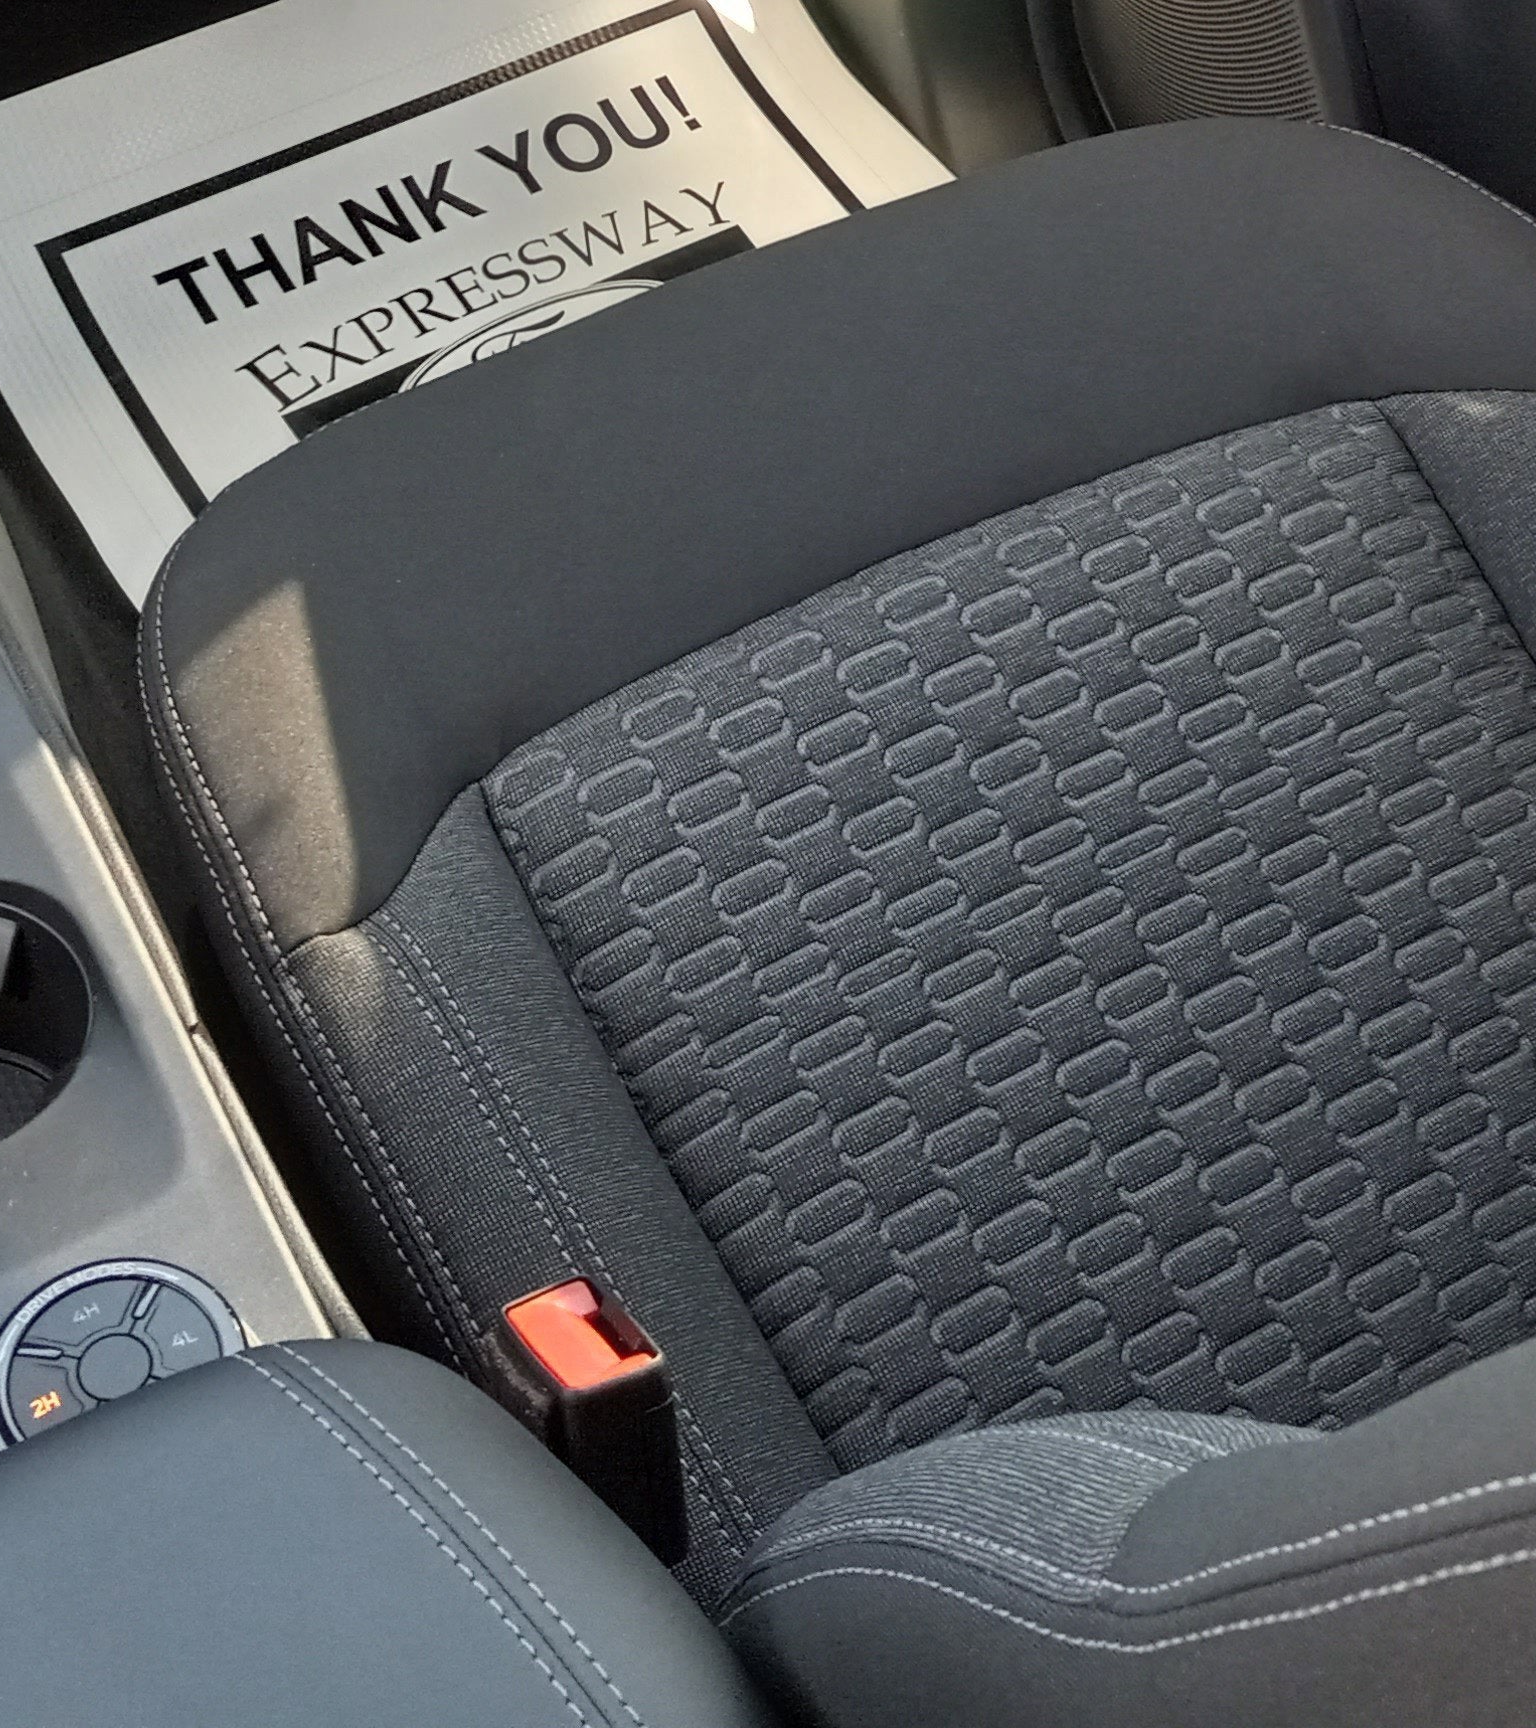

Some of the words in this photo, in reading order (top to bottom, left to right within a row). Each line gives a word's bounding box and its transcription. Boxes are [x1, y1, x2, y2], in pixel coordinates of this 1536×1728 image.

[152, 159, 488, 325] THANK
[476, 75, 703, 196] YOU!
[234, 181, 735, 412] EXPRESSWAY
[14, 1280, 66, 1324] DRIVE
[65, 1261, 138, 1286] MODES
[72, 1302, 101, 1324] 4H
[170, 1330, 199, 1348] 4L
[29, 1390, 62, 1419] 2H
